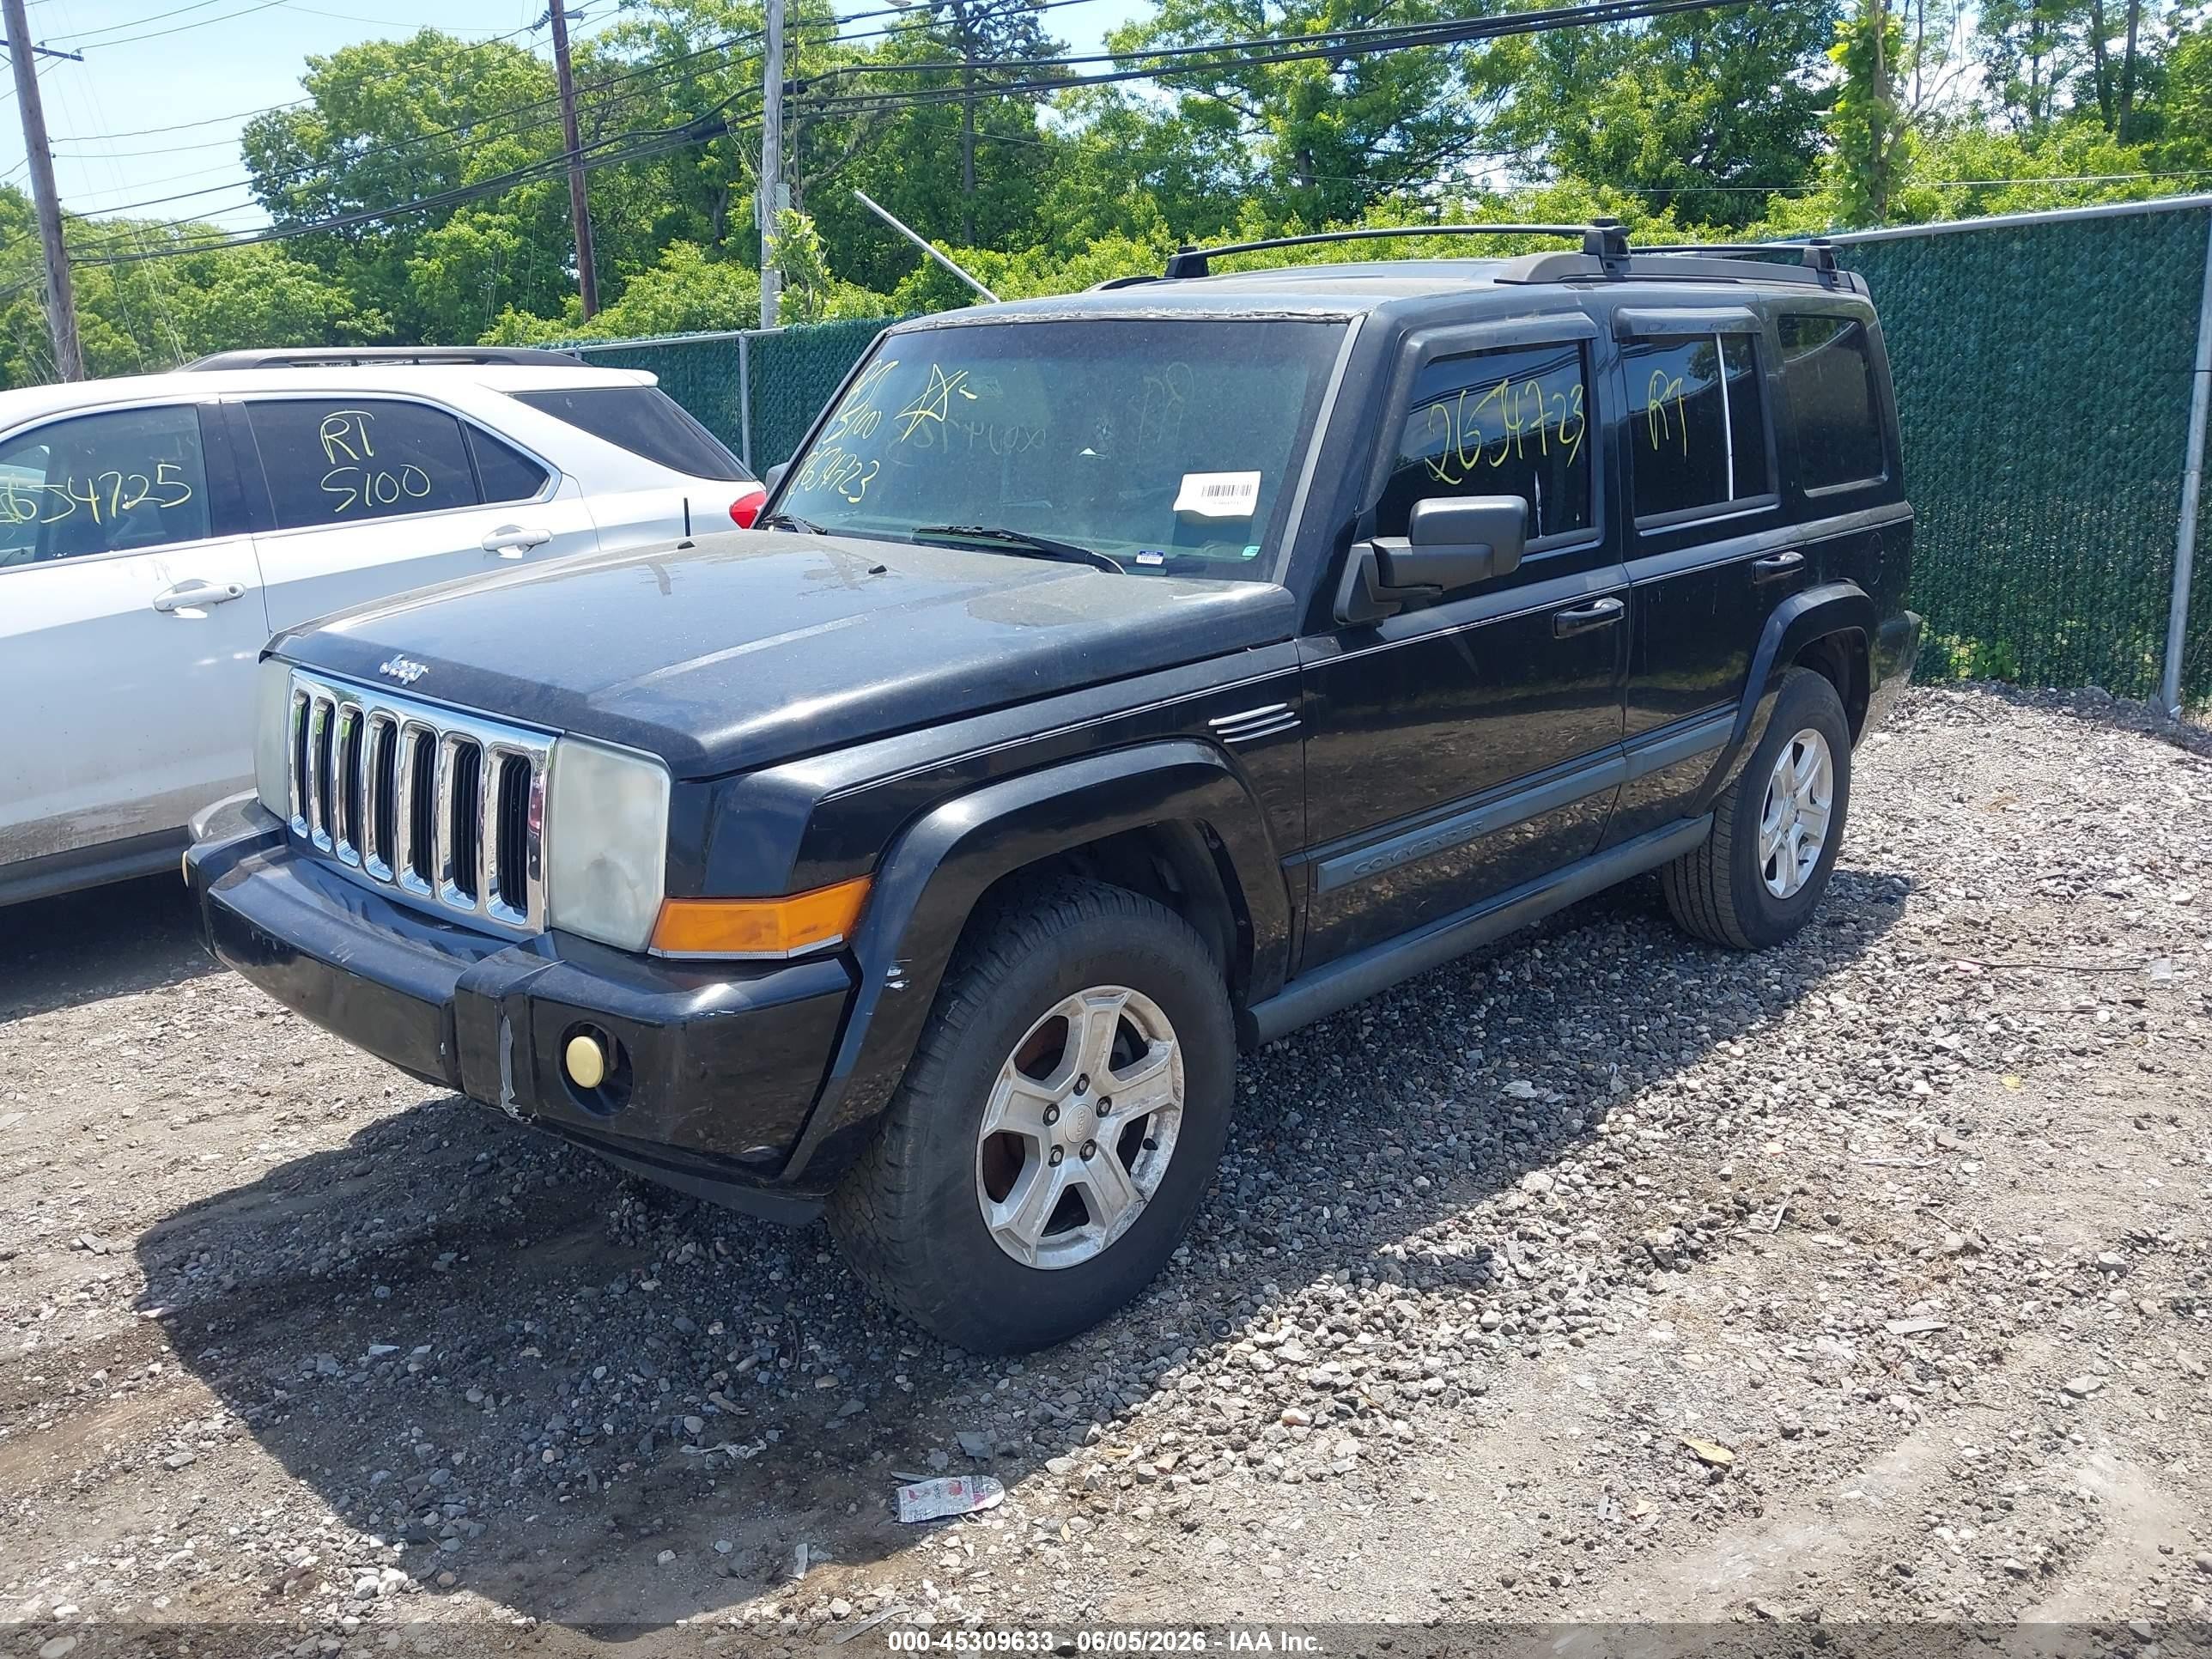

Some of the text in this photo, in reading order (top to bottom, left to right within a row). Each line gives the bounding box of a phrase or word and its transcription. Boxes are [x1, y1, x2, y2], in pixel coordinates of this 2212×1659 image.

[319, 410, 375, 465] RT
[1425, 379, 1586, 485] 2654723
[1647, 369, 1688, 462] RT
[379, 653, 429, 686] Jeep
